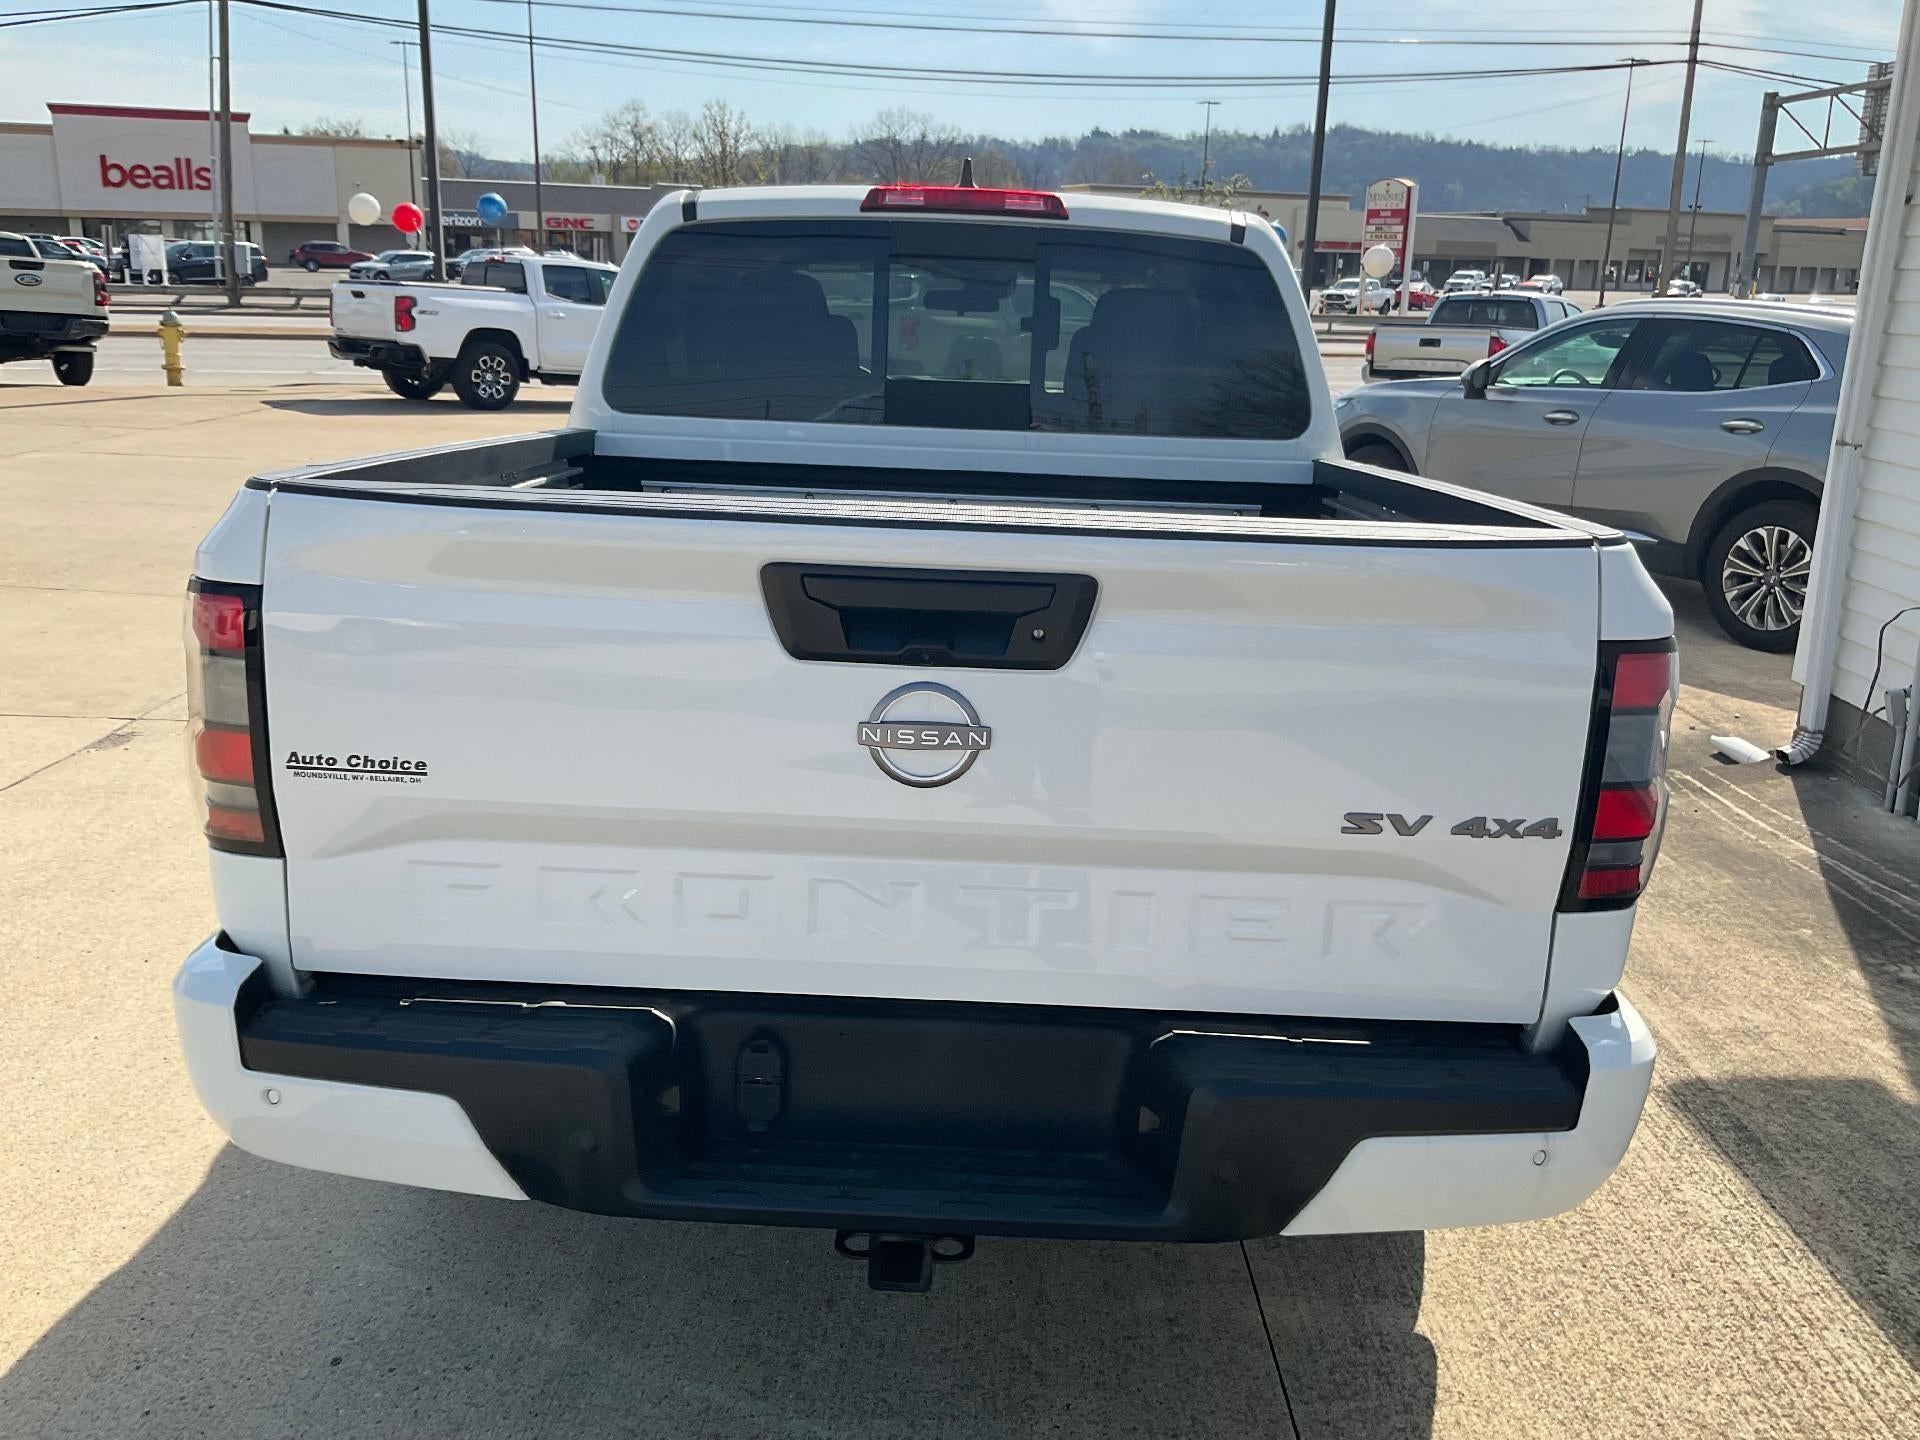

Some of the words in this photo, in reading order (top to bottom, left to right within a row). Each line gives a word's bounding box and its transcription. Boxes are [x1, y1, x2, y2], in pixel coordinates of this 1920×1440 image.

[99, 154, 211, 190] bealls
[441, 213, 483, 227] erizon
[545, 217, 594, 230] GNC
[861, 727, 987, 746] NISSAN
[286, 751, 338, 767] Auto
[346, 754, 428, 771] Choice
[1341, 812, 1434, 837] SV
[405, 860, 1440, 964] FRONTIER
